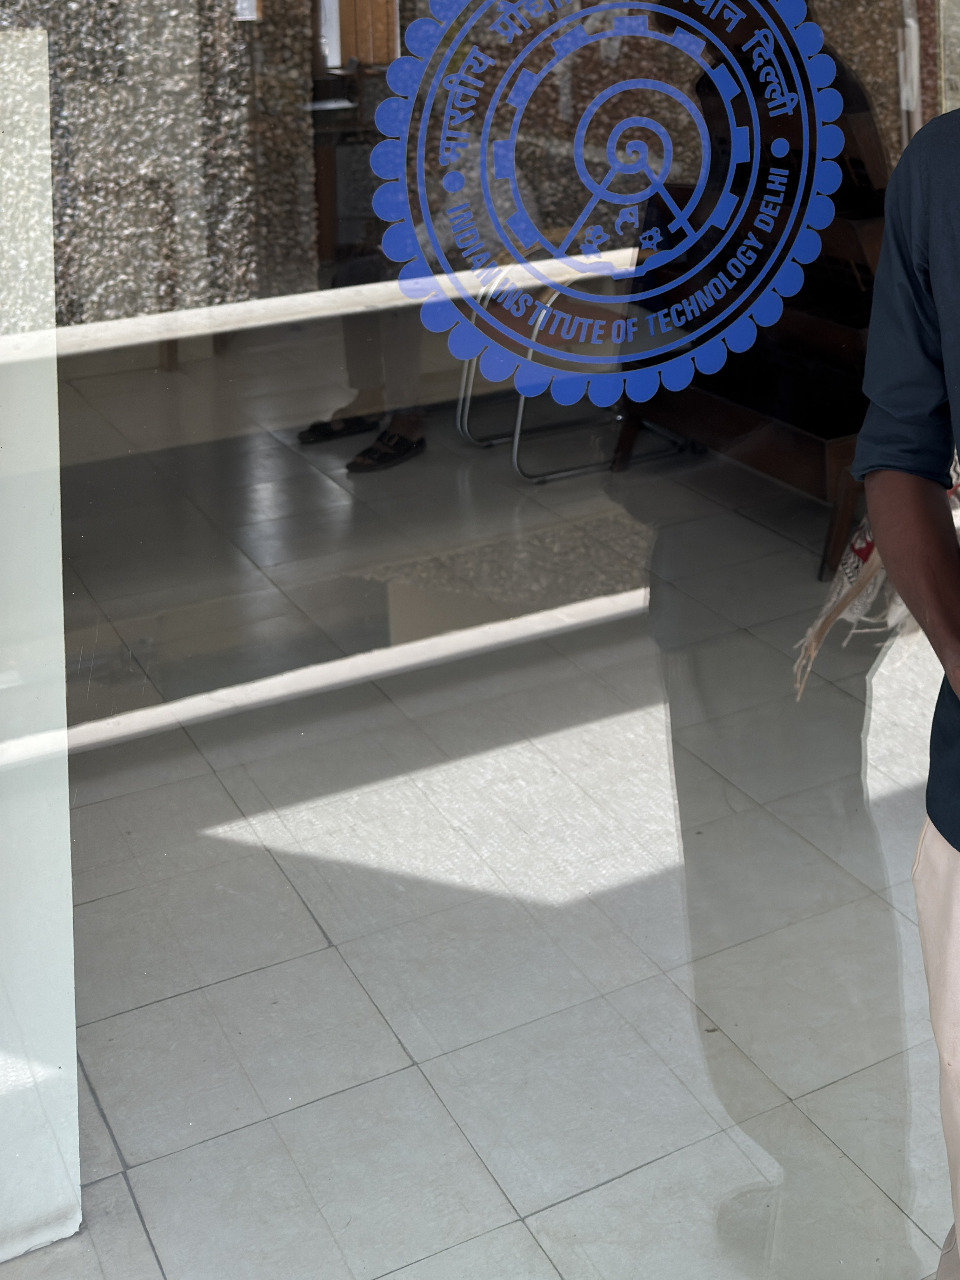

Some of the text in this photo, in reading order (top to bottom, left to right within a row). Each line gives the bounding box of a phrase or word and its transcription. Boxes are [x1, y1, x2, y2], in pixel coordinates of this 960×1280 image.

[438, 44, 496, 166] भारतीय
[741, 28, 799, 118] दिल्ली
[446, 167, 789, 345] INDIAN INSTITUTE OF TECHNOLOGY DELHI
